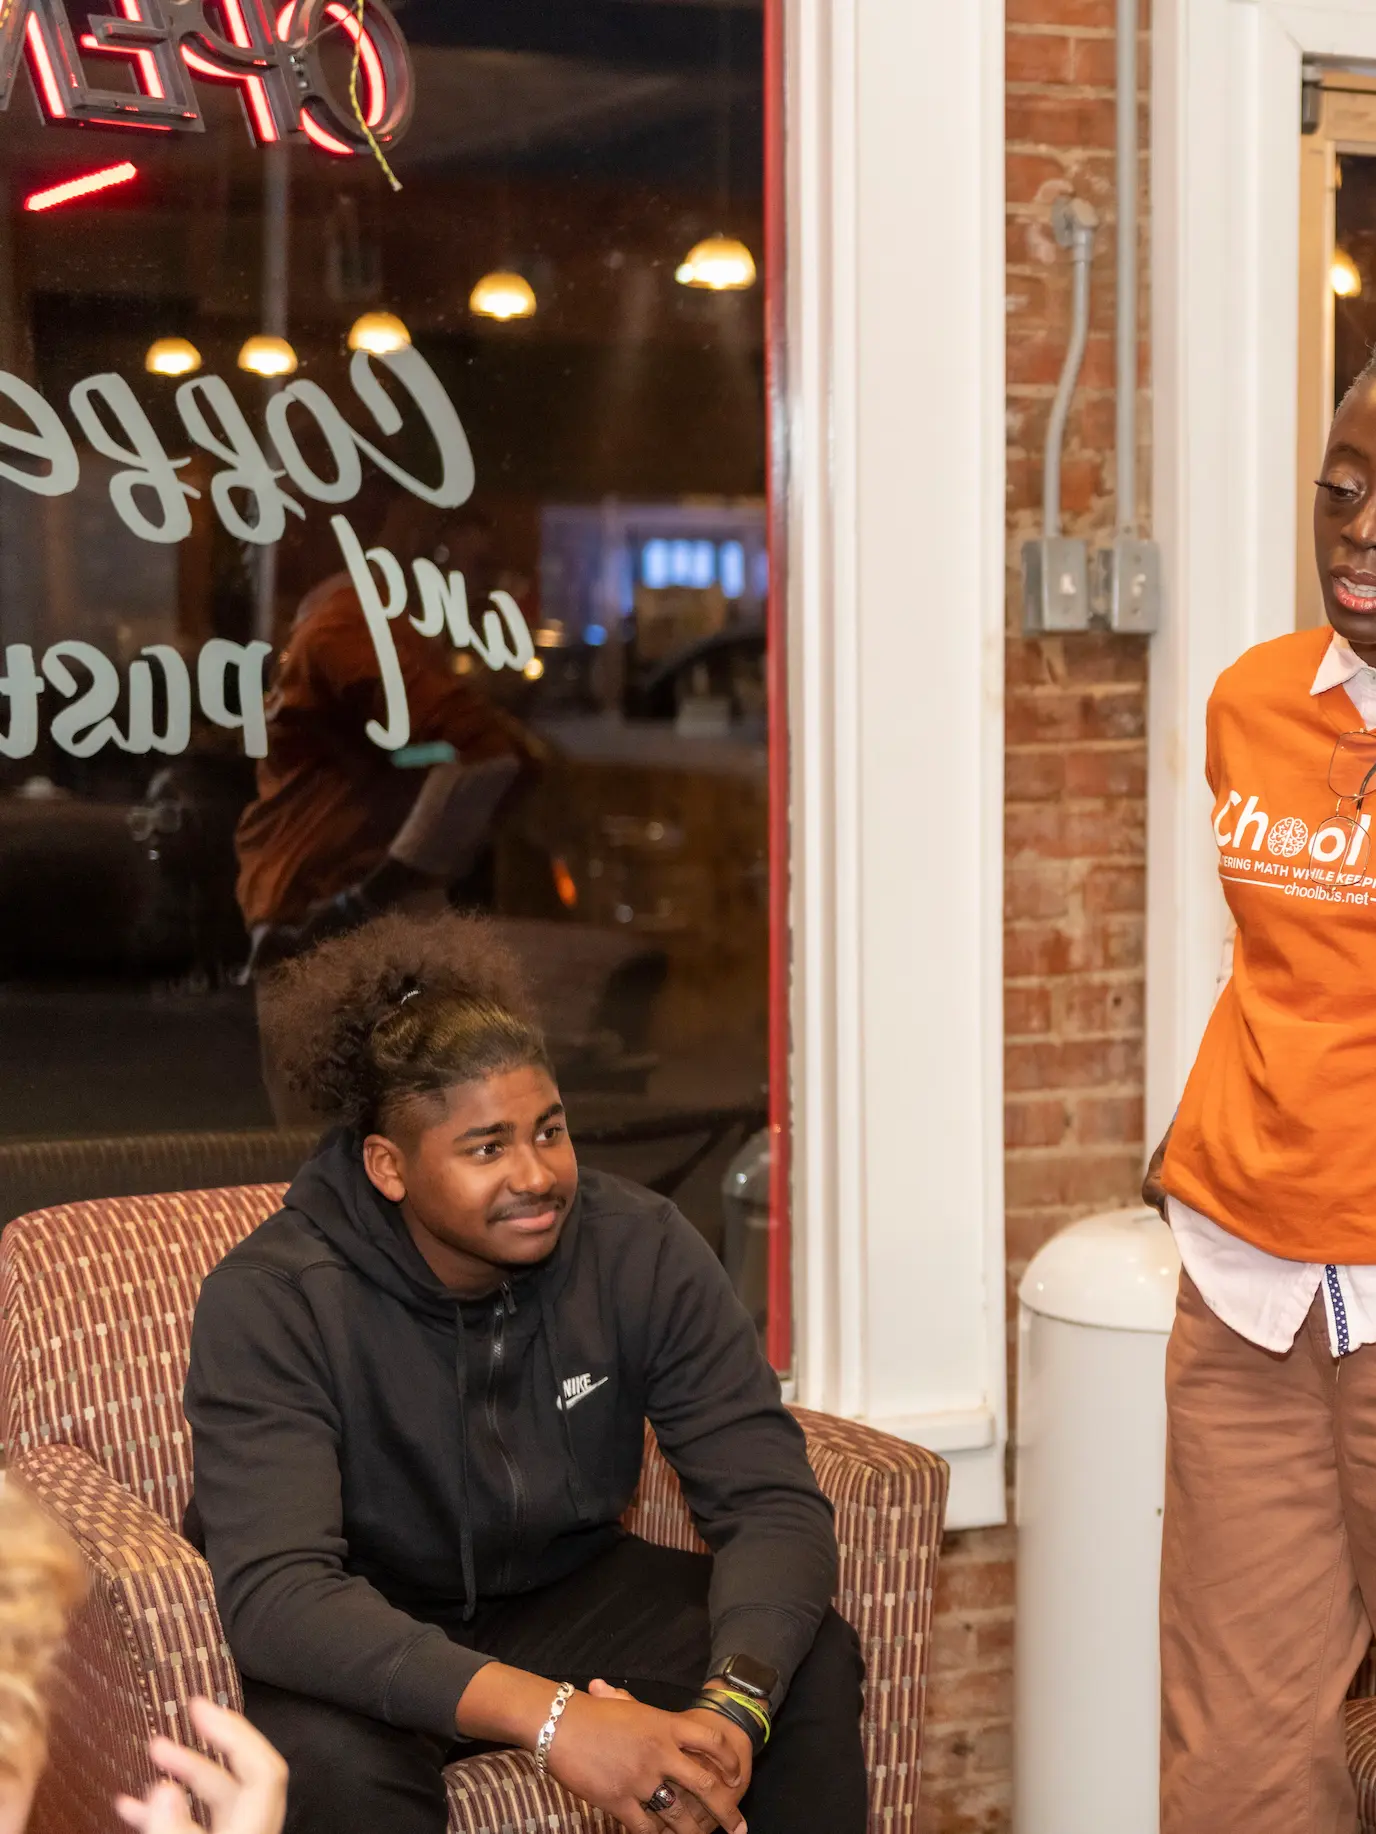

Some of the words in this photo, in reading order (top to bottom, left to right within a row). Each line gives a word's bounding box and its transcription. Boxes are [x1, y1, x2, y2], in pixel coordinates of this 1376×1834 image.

[1221, 854, 1251, 870] ERING
[1254, 860, 1289, 877] MATH
[1293, 866, 1335, 882] WHILE
[1284, 882, 1369, 905] choolbus.net
[562, 1372, 592, 1398] NIKE
